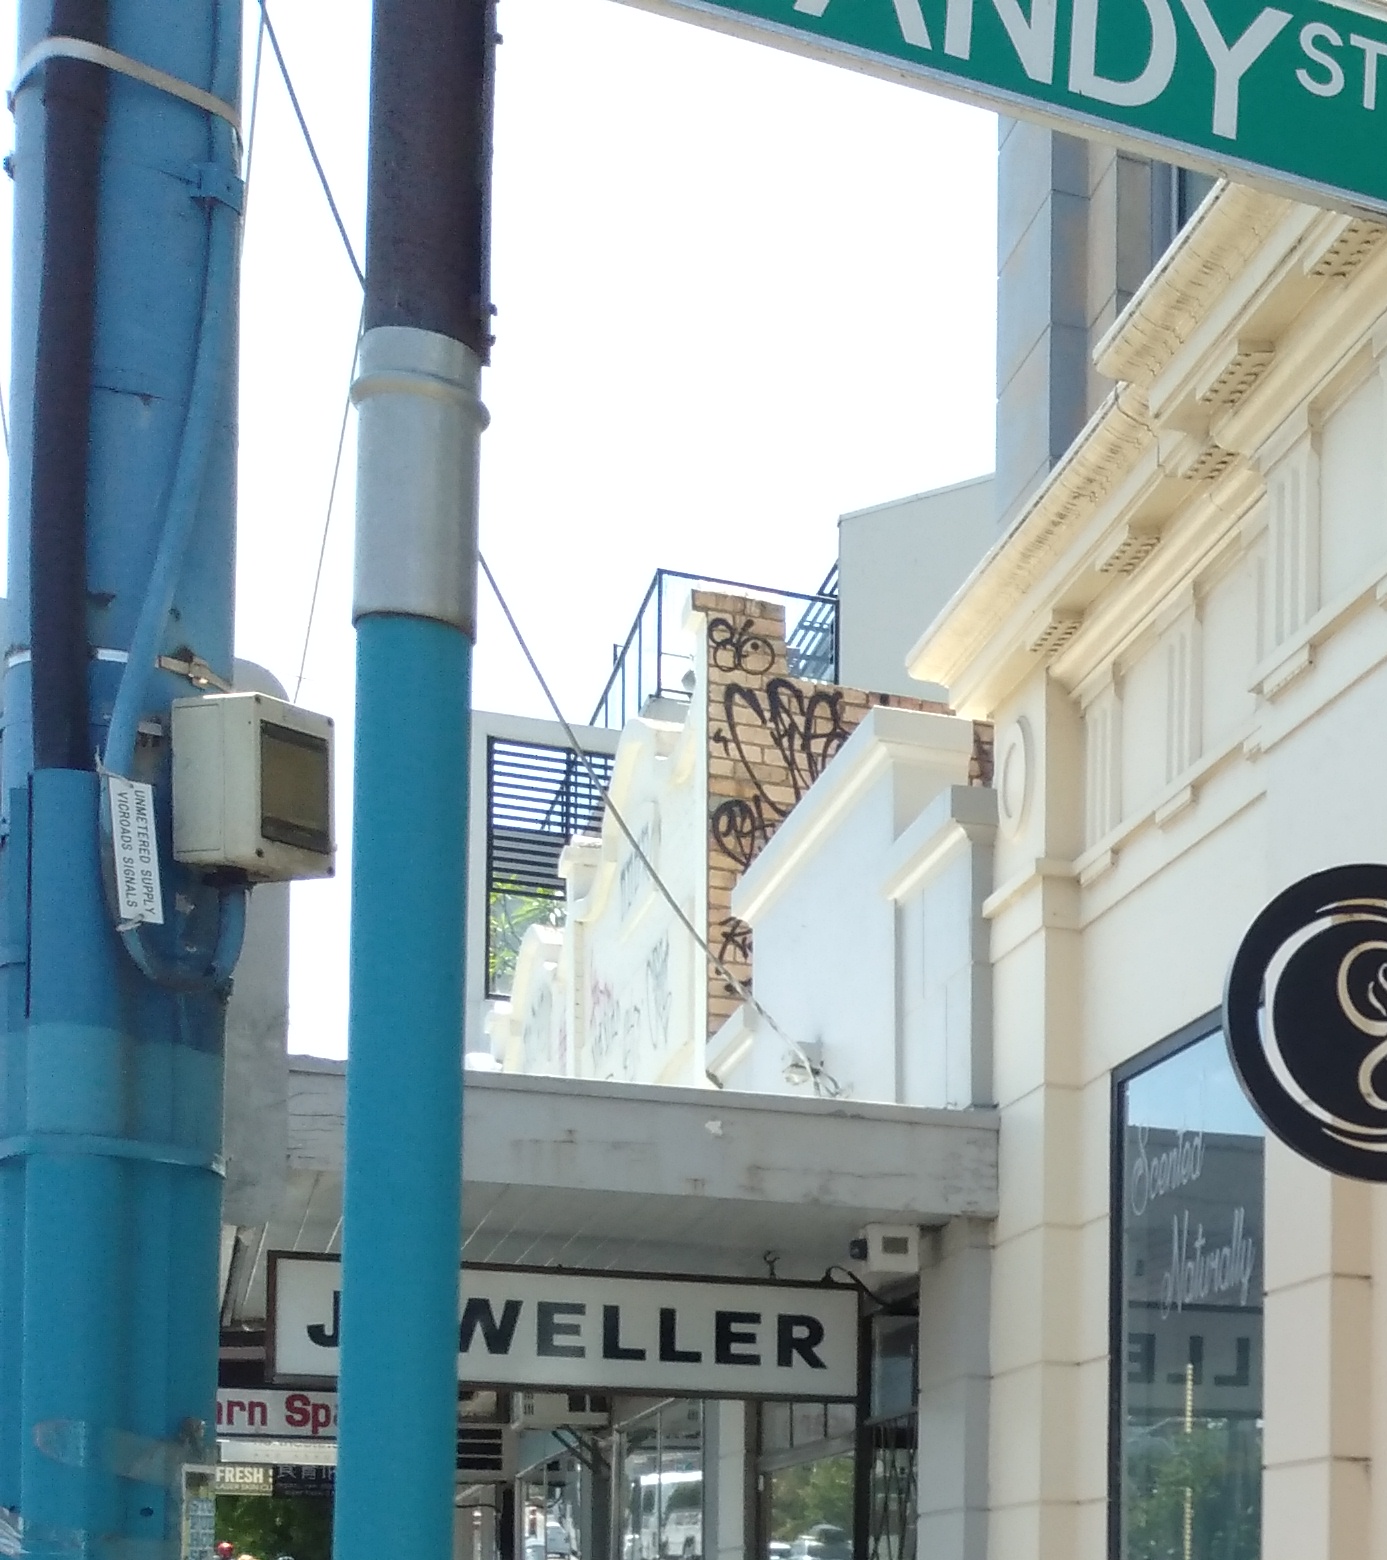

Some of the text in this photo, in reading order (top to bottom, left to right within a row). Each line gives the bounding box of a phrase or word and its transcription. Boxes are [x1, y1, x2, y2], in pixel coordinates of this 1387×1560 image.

[793, 0, 1292, 139] NDY
[117, 791, 138, 908] VICROADS SIGNALS
[134, 789, 155, 915] UNMETERED SUPPLY
[307, 1289, 827, 1370] JWELLER
[285, 1393, 338, 1435] Sp
[215, 1466, 263, 1483] FRESH
